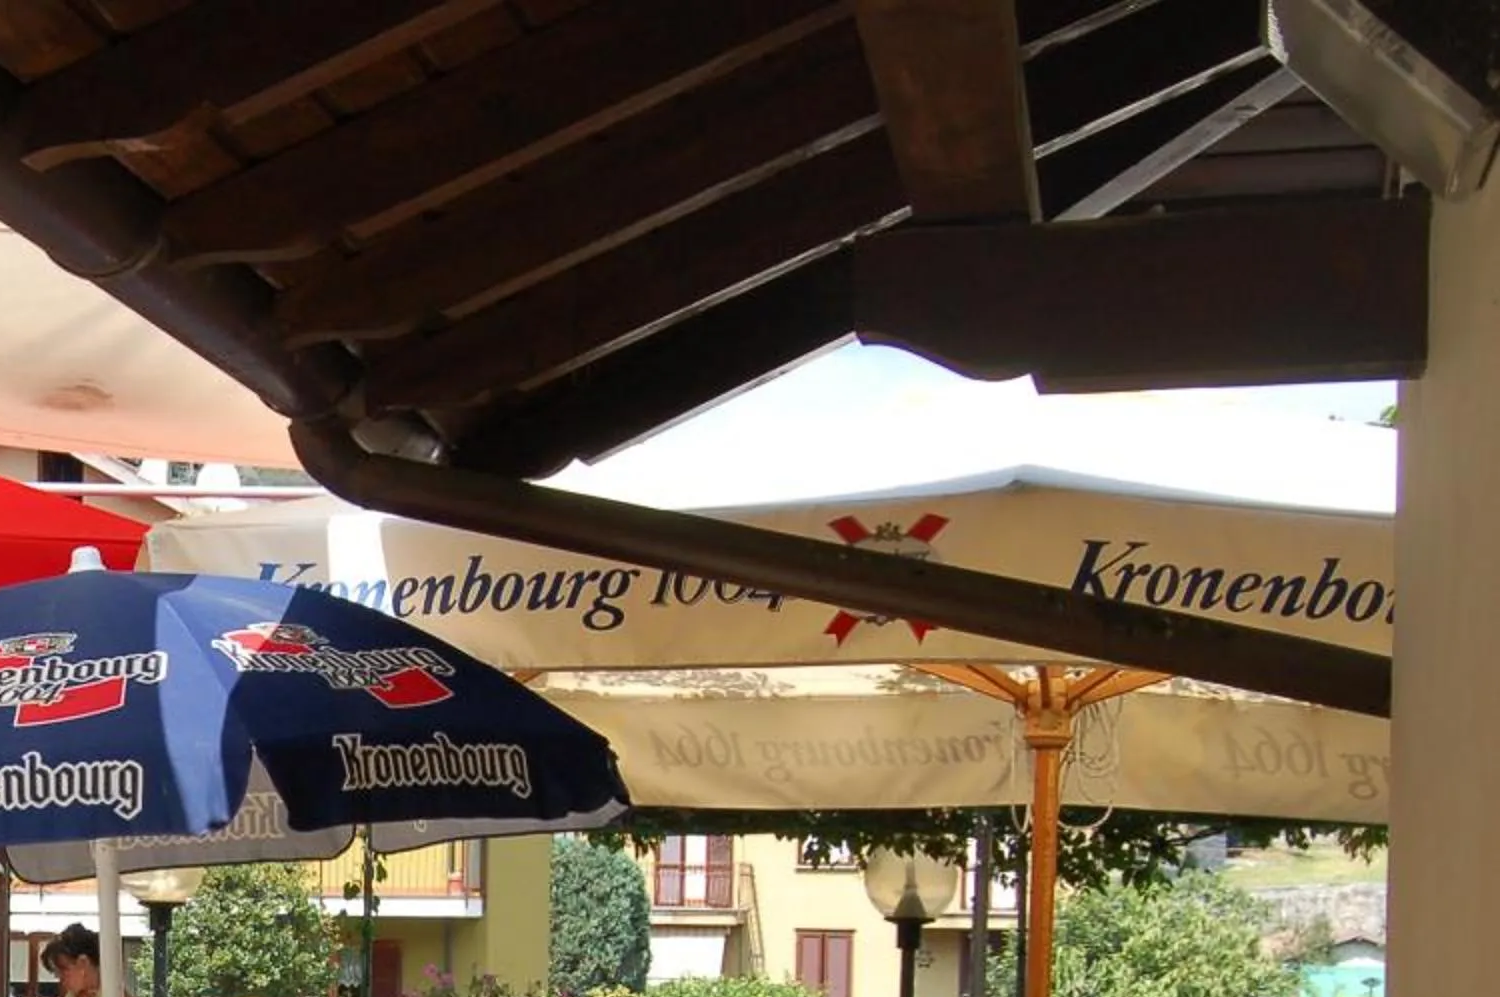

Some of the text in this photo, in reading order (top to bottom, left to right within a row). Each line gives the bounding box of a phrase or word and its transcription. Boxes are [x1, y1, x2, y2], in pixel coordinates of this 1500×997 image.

[258, 555, 640, 631] nenbourg
[1071, 539, 1394, 625] Kronenbo
[332, 731, 532, 799] Kronenbourg
